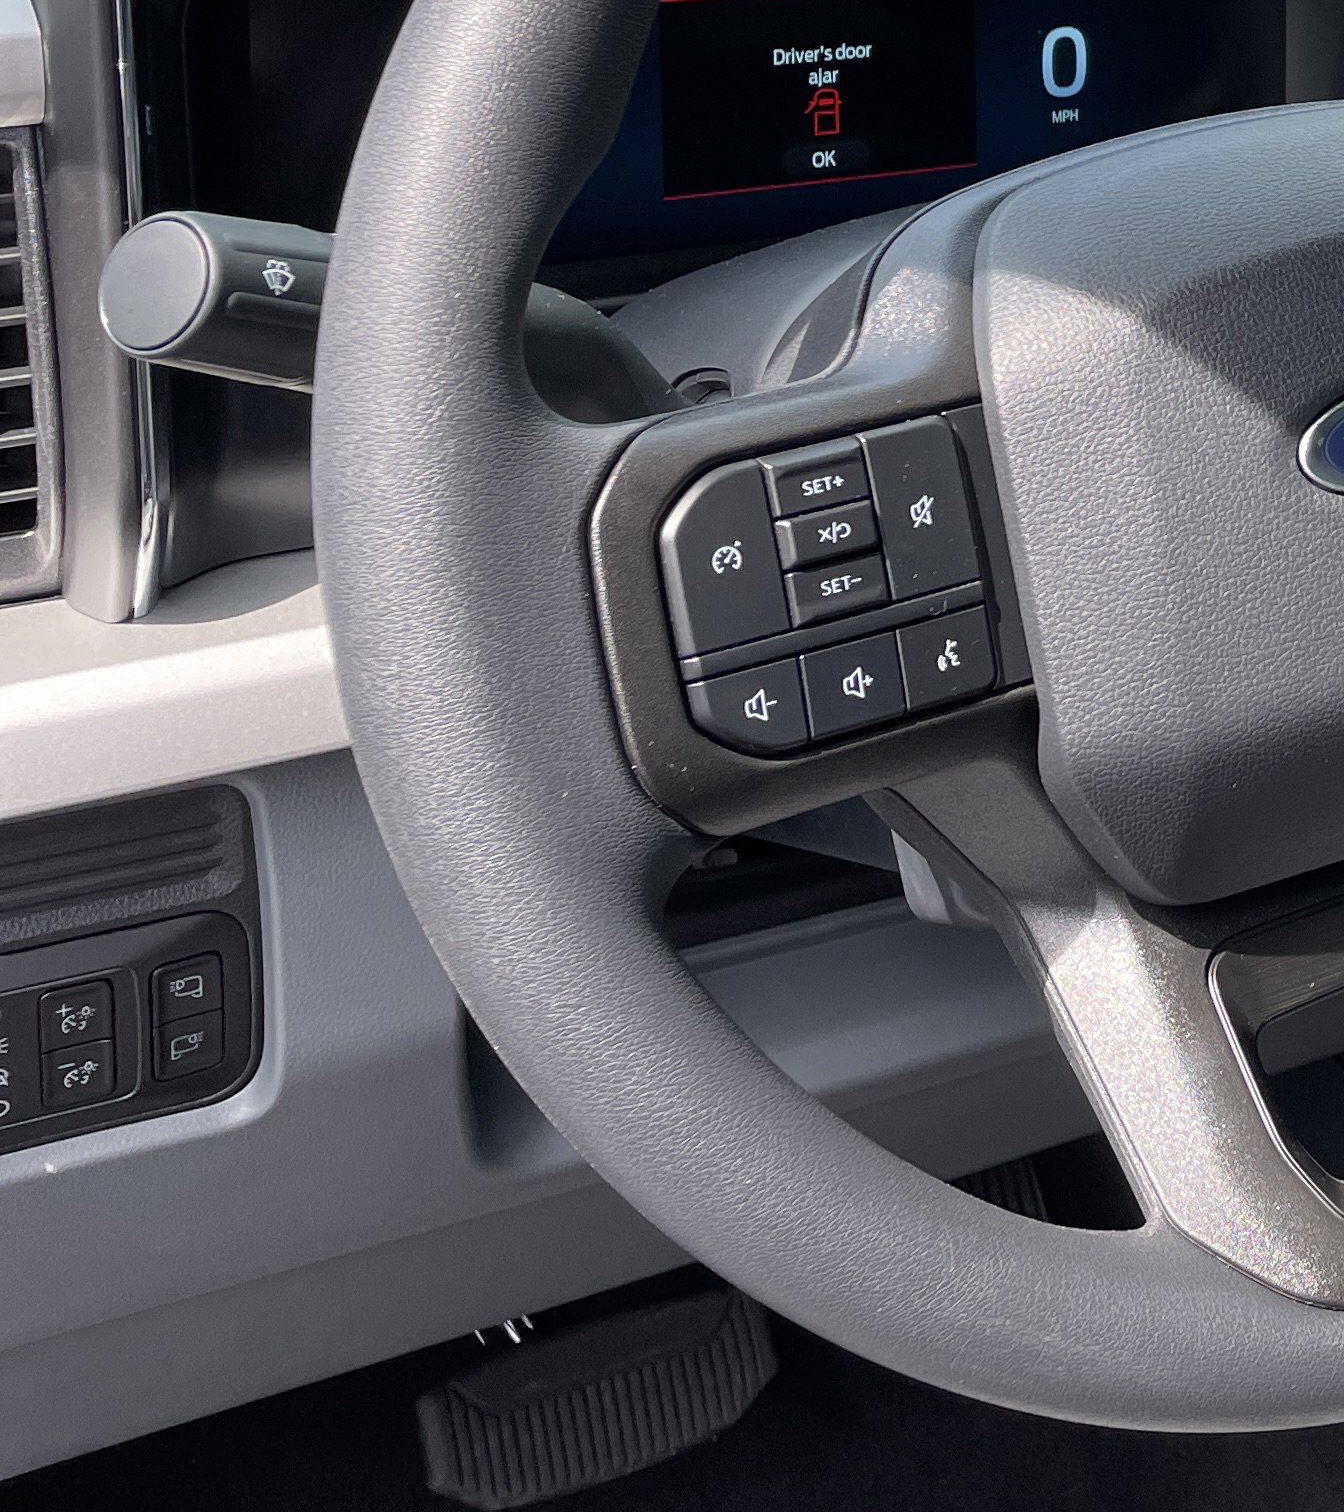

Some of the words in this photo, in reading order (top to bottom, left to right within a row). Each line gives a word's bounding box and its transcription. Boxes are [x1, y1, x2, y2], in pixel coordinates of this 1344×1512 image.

[772, 44, 832, 67] Driver's
[835, 41, 872, 61] door
[1041, 25, 1088, 98] 0
[807, 66, 839, 87] ajar
[1051, 107, 1079, 124] MPH
[812, 150, 837, 169] OK
[801, 474, 845, 498] SET+
